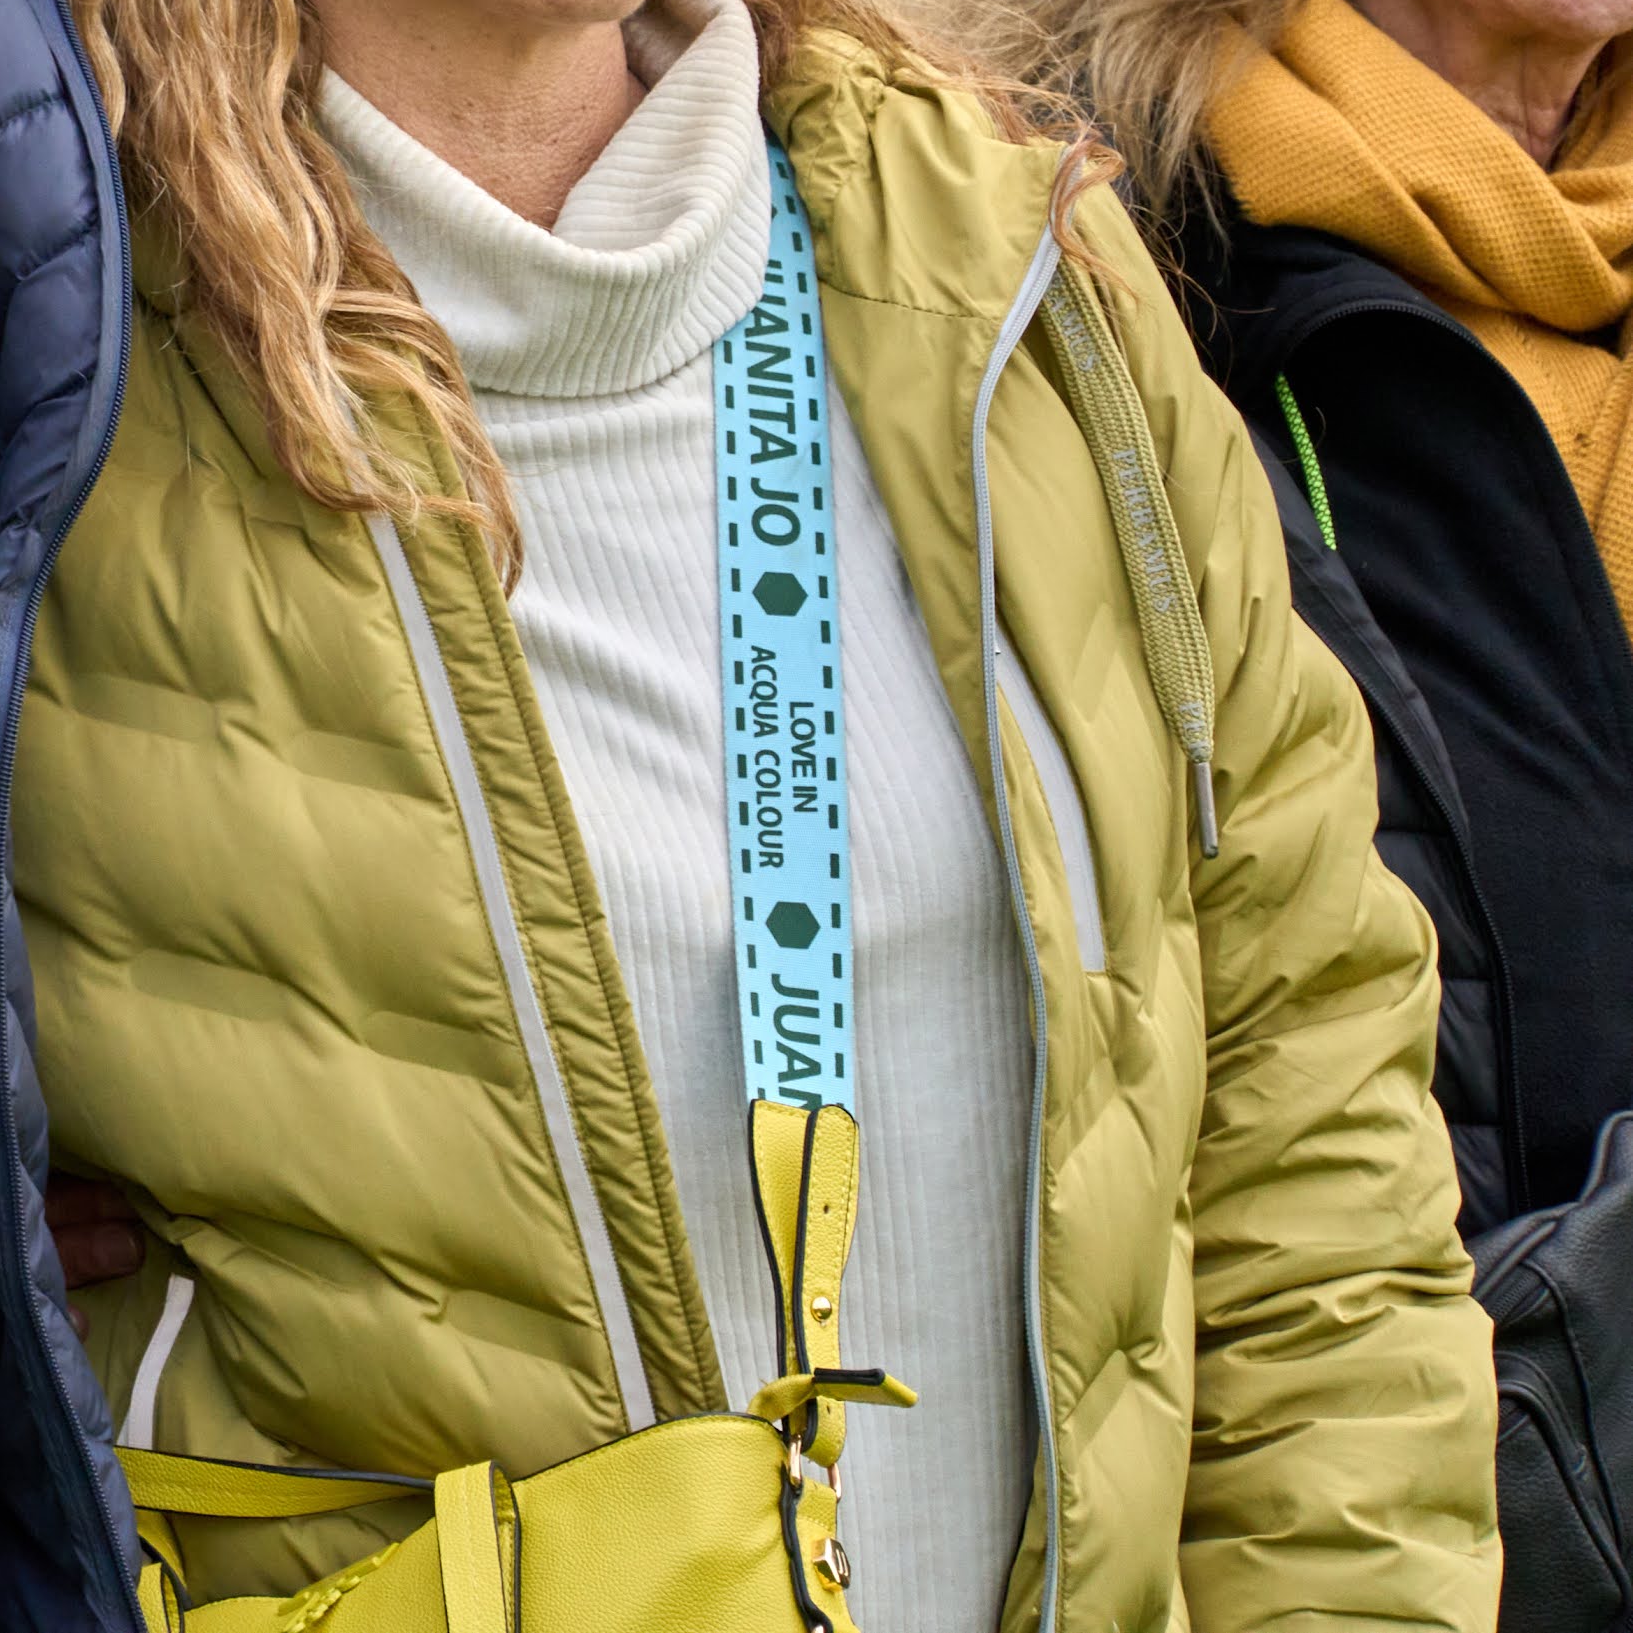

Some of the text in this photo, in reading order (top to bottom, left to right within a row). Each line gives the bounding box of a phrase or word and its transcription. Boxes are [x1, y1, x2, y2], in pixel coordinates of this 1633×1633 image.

[750, 477, 802, 547] JO
[1113, 448, 1178, 613] PERRAMUS
[749, 645, 785, 868] ACQUA COLOUR
[789, 701, 818, 812] LOVE IN
